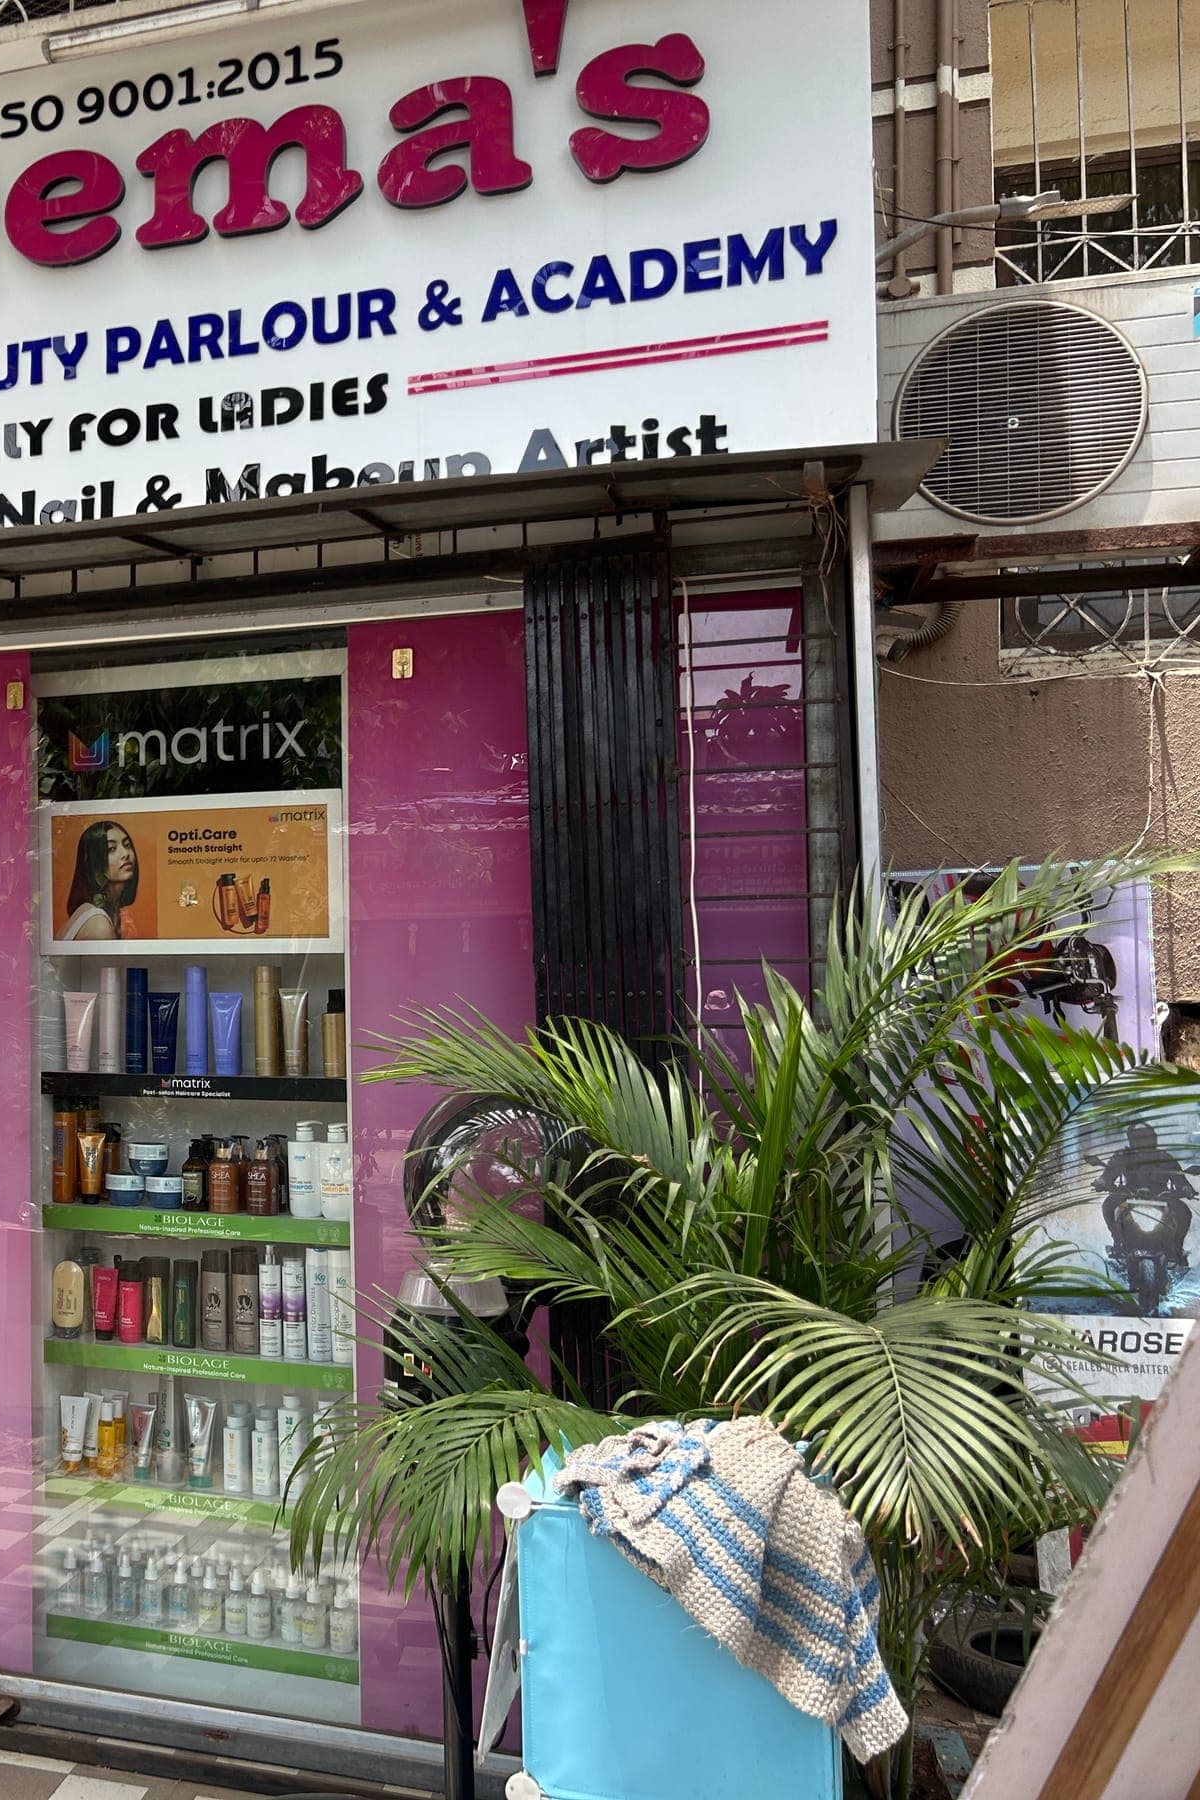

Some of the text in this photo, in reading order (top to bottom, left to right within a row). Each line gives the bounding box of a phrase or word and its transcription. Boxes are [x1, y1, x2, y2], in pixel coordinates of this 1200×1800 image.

[76, 38, 344, 124] 9001:2015
[104, 287, 398, 374] PARLOUR
[417, 279, 462, 331] &
[482, 219, 839, 322] ACADEMY
[68, 401, 179, 453] FOR
[198, 372, 390, 433] LADIES
[135, 474, 183, 515] &
[516, 414, 729, 474] Artist
[117, 710, 309, 769] matrix
[280, 808, 326, 823] matrix
[167, 828, 238, 843] Opti.Care
[167, 843, 243, 854] Smooth Straight
[171, 1077, 211, 1089] matrix
[163, 1214, 224, 1227] BIOLAGE
[1034, 1328, 1184, 1355] AROSE
[167, 1354, 230, 1369] BIOLAGE
